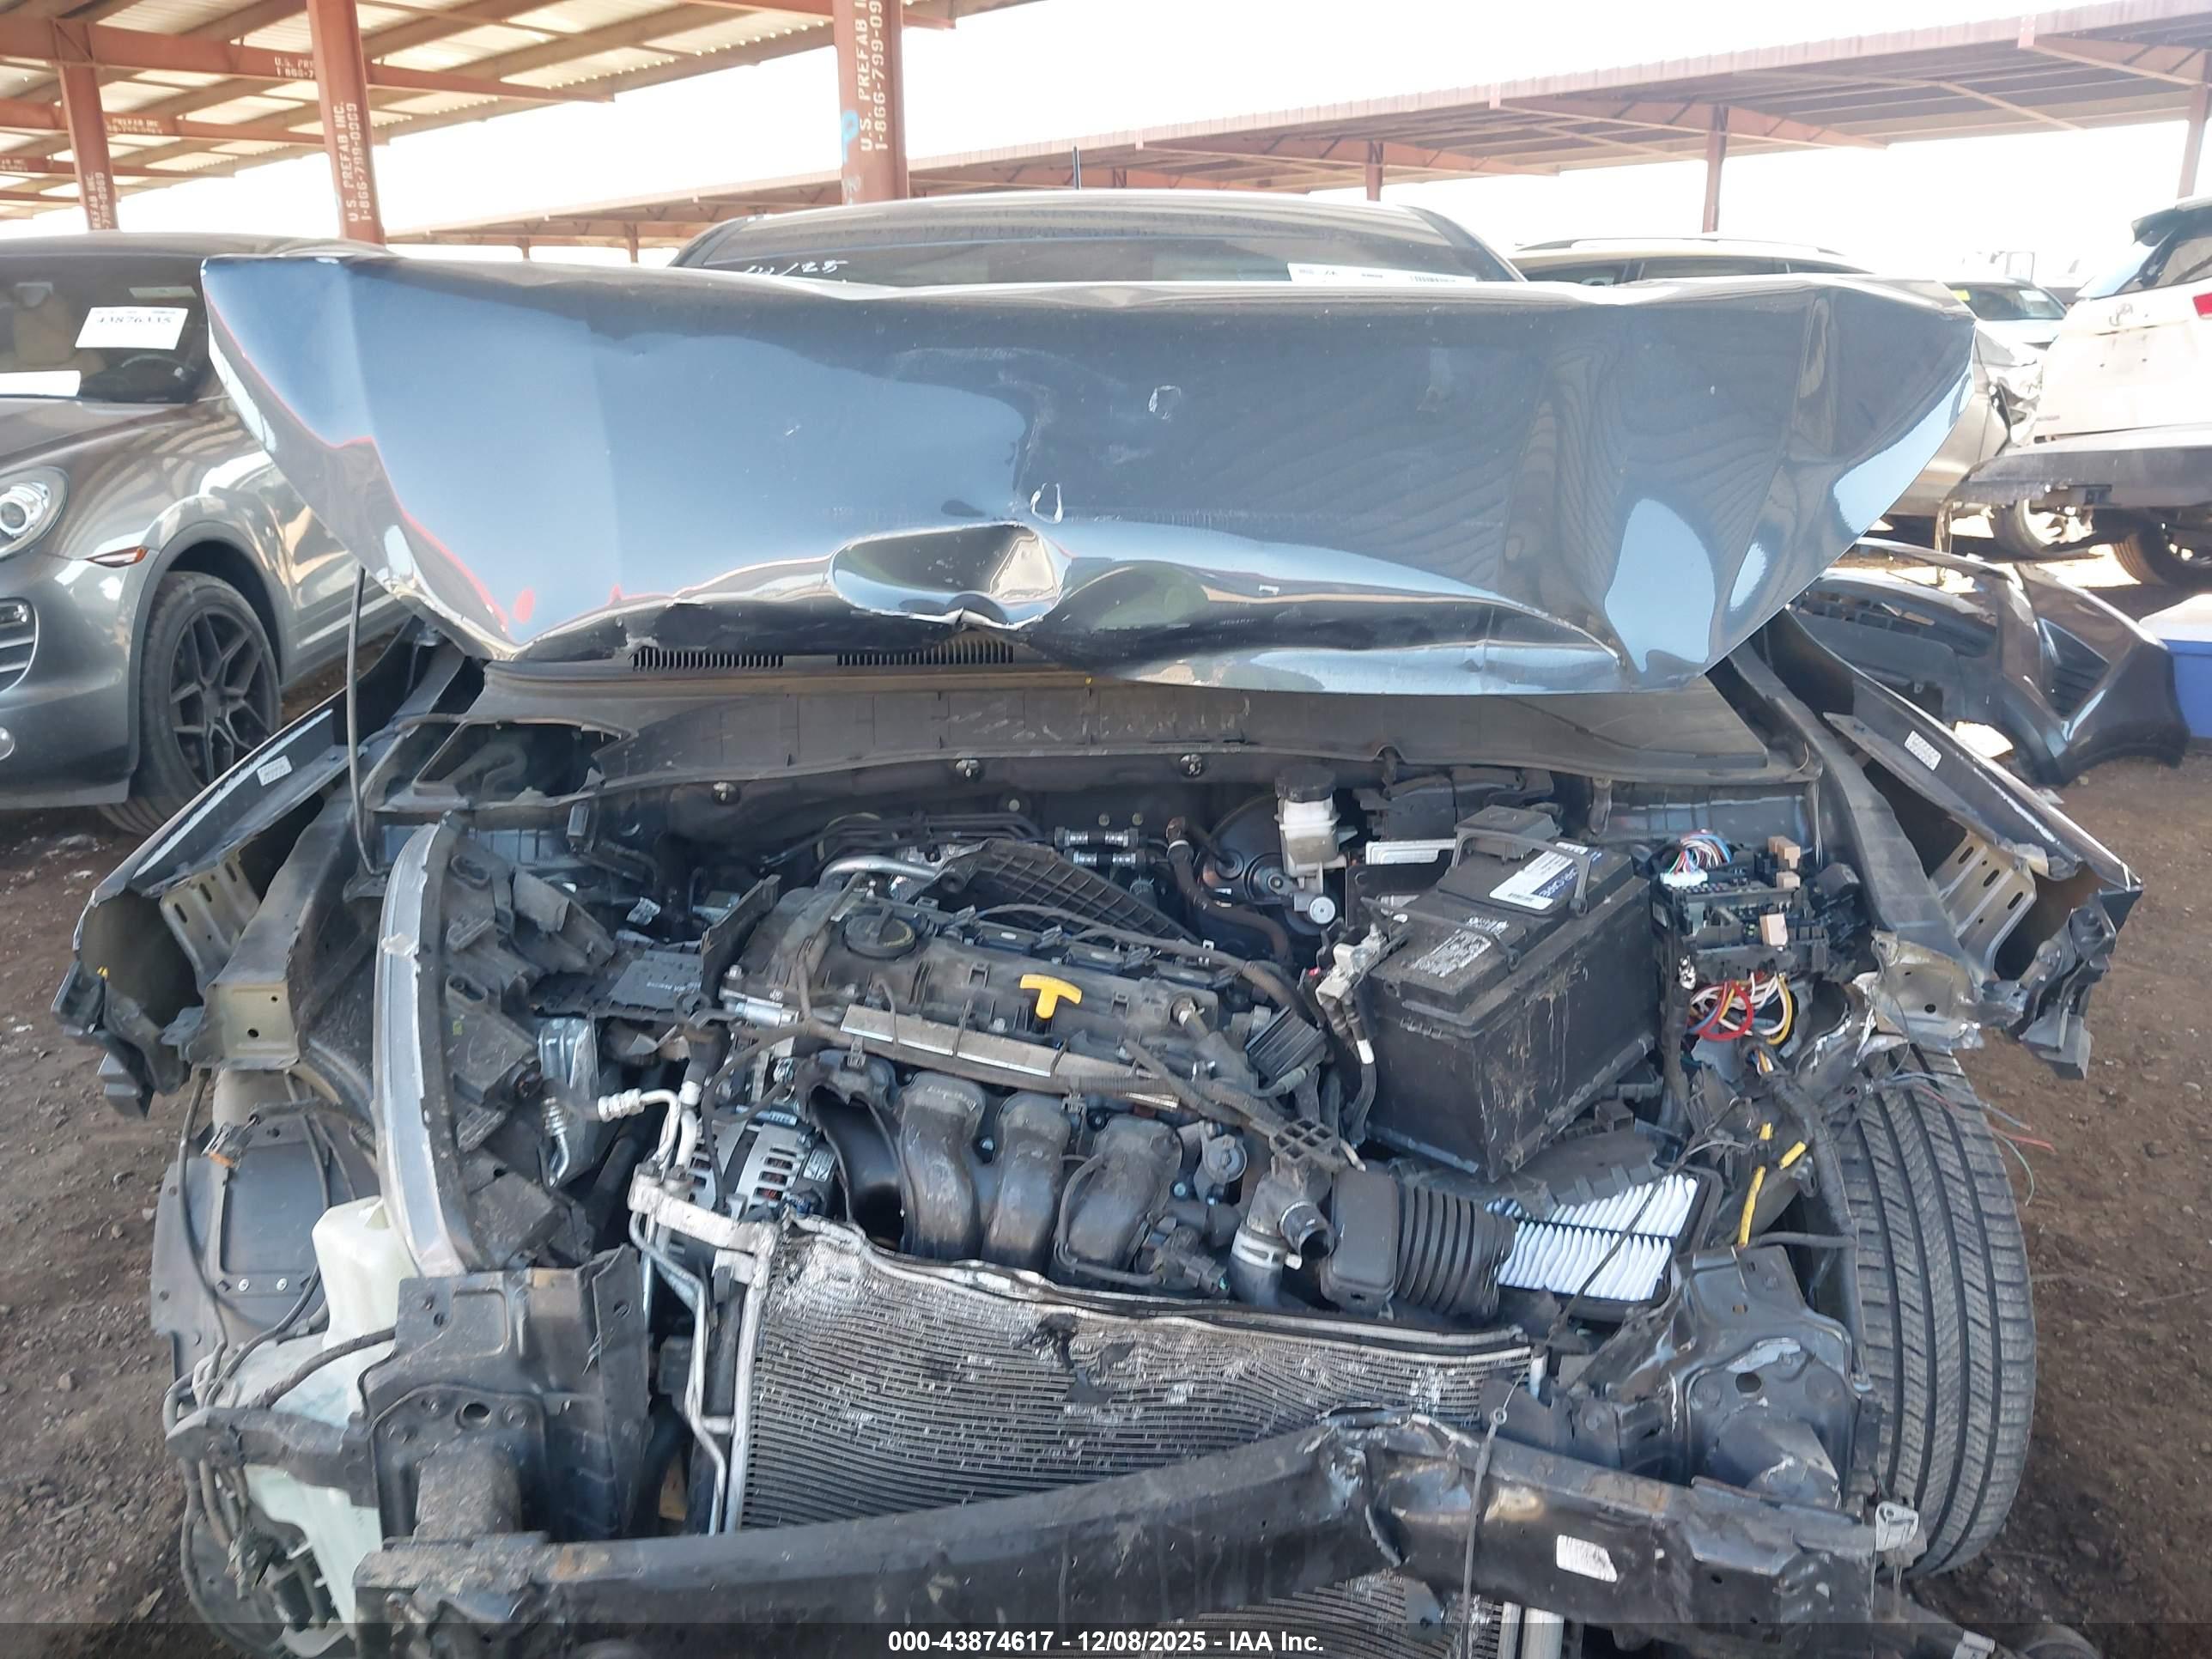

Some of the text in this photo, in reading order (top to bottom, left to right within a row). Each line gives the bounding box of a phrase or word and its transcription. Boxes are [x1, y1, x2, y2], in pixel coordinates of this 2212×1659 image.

[854, 18, 871, 100] PREFAB
[333, 101, 347, 128] INC.
[860, 112, 873, 151] U.S.
[337, 134, 355, 189] PREFAB
